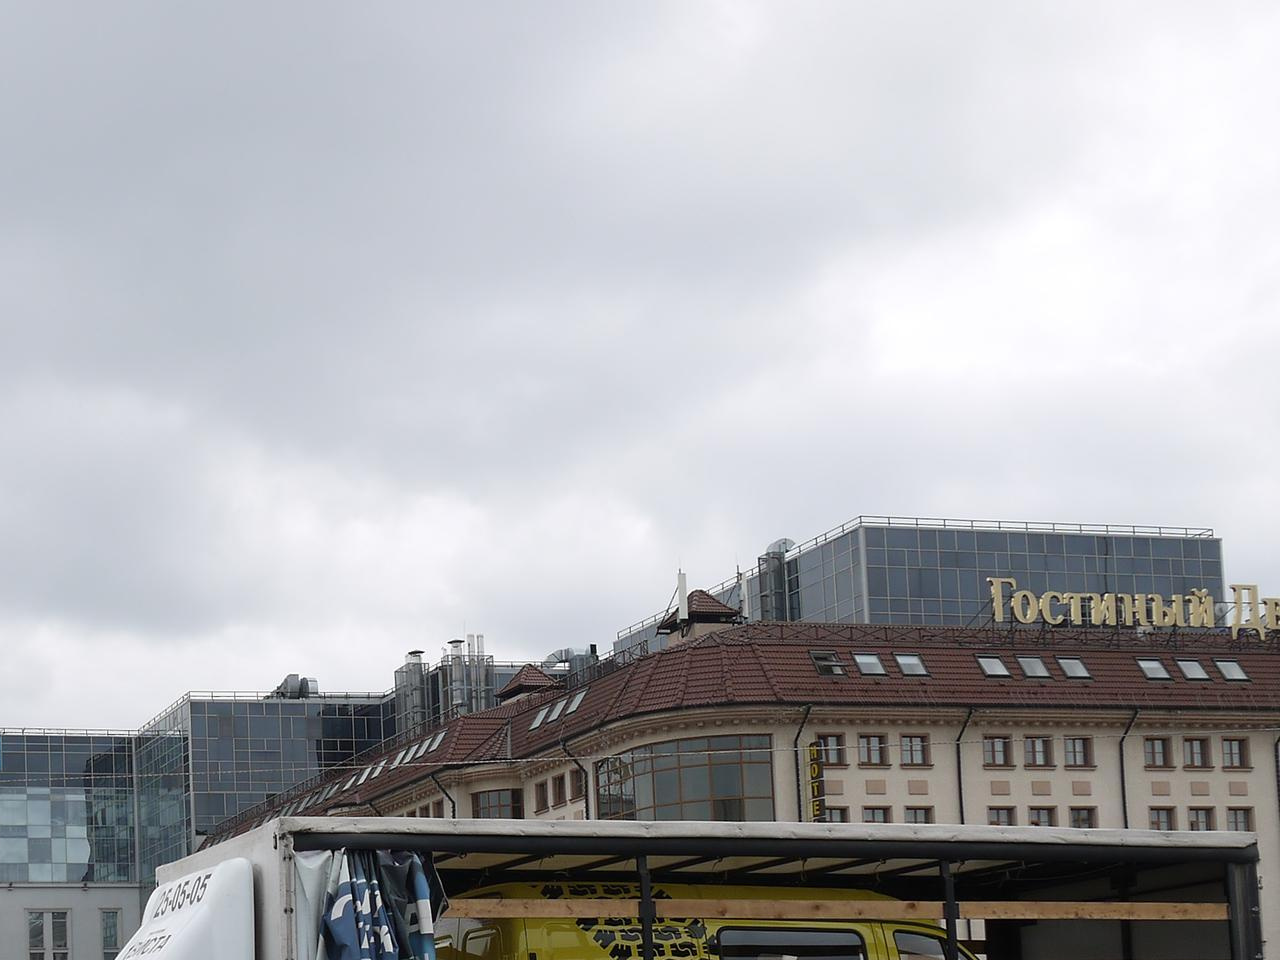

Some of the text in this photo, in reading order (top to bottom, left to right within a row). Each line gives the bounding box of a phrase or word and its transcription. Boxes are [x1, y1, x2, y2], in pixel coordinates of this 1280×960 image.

[986, 577, 1215, 628] Гостиный
[809, 744, 821, 821] HOTE
[153, 873, 213, 919] 25-05-05
